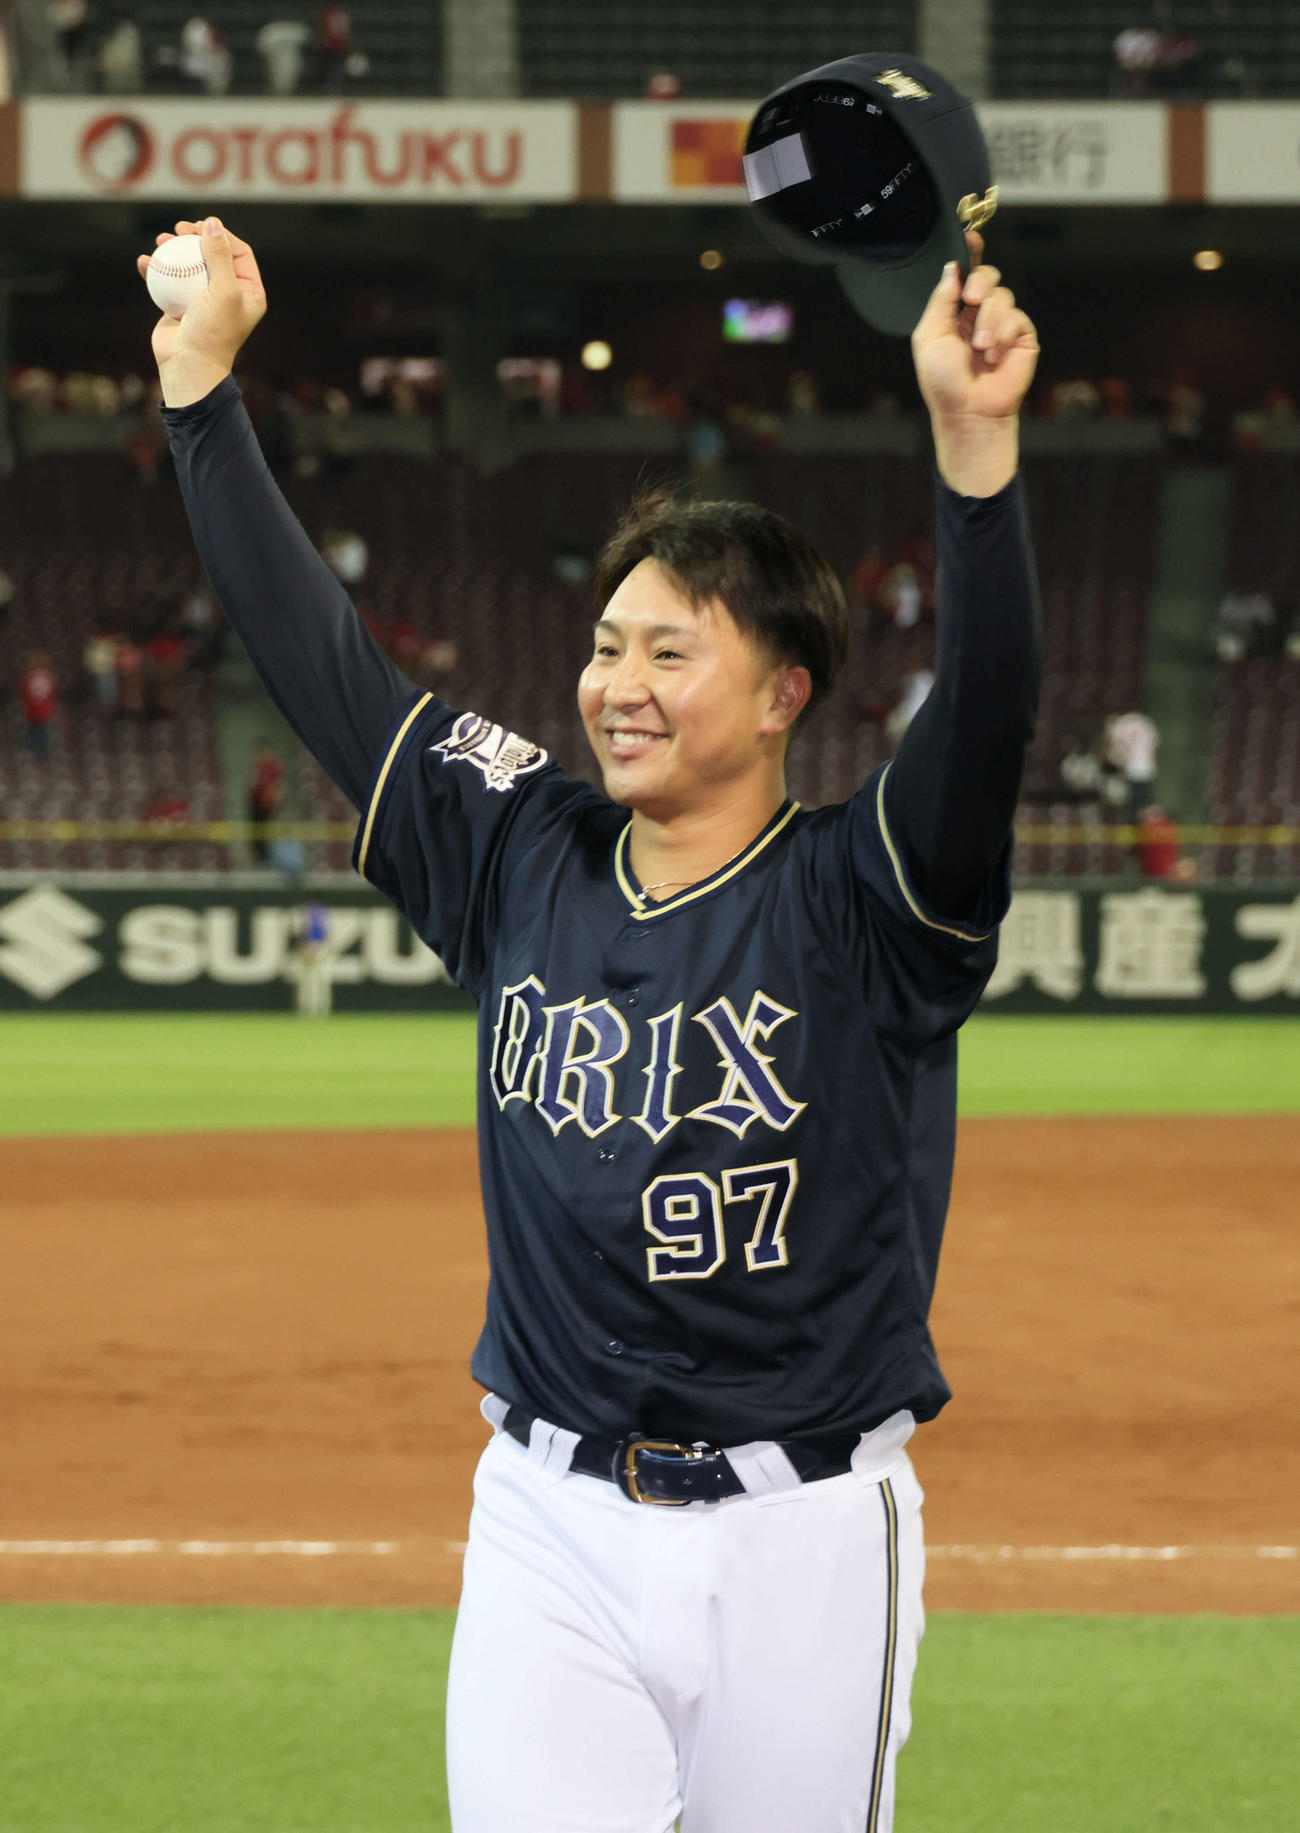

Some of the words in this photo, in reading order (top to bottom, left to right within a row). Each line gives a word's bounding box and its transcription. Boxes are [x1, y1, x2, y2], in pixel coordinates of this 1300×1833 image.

[119, 904, 446, 984] SUZU
[490, 974, 808, 1144] ORIX
[641, 1158, 798, 1282] 97
